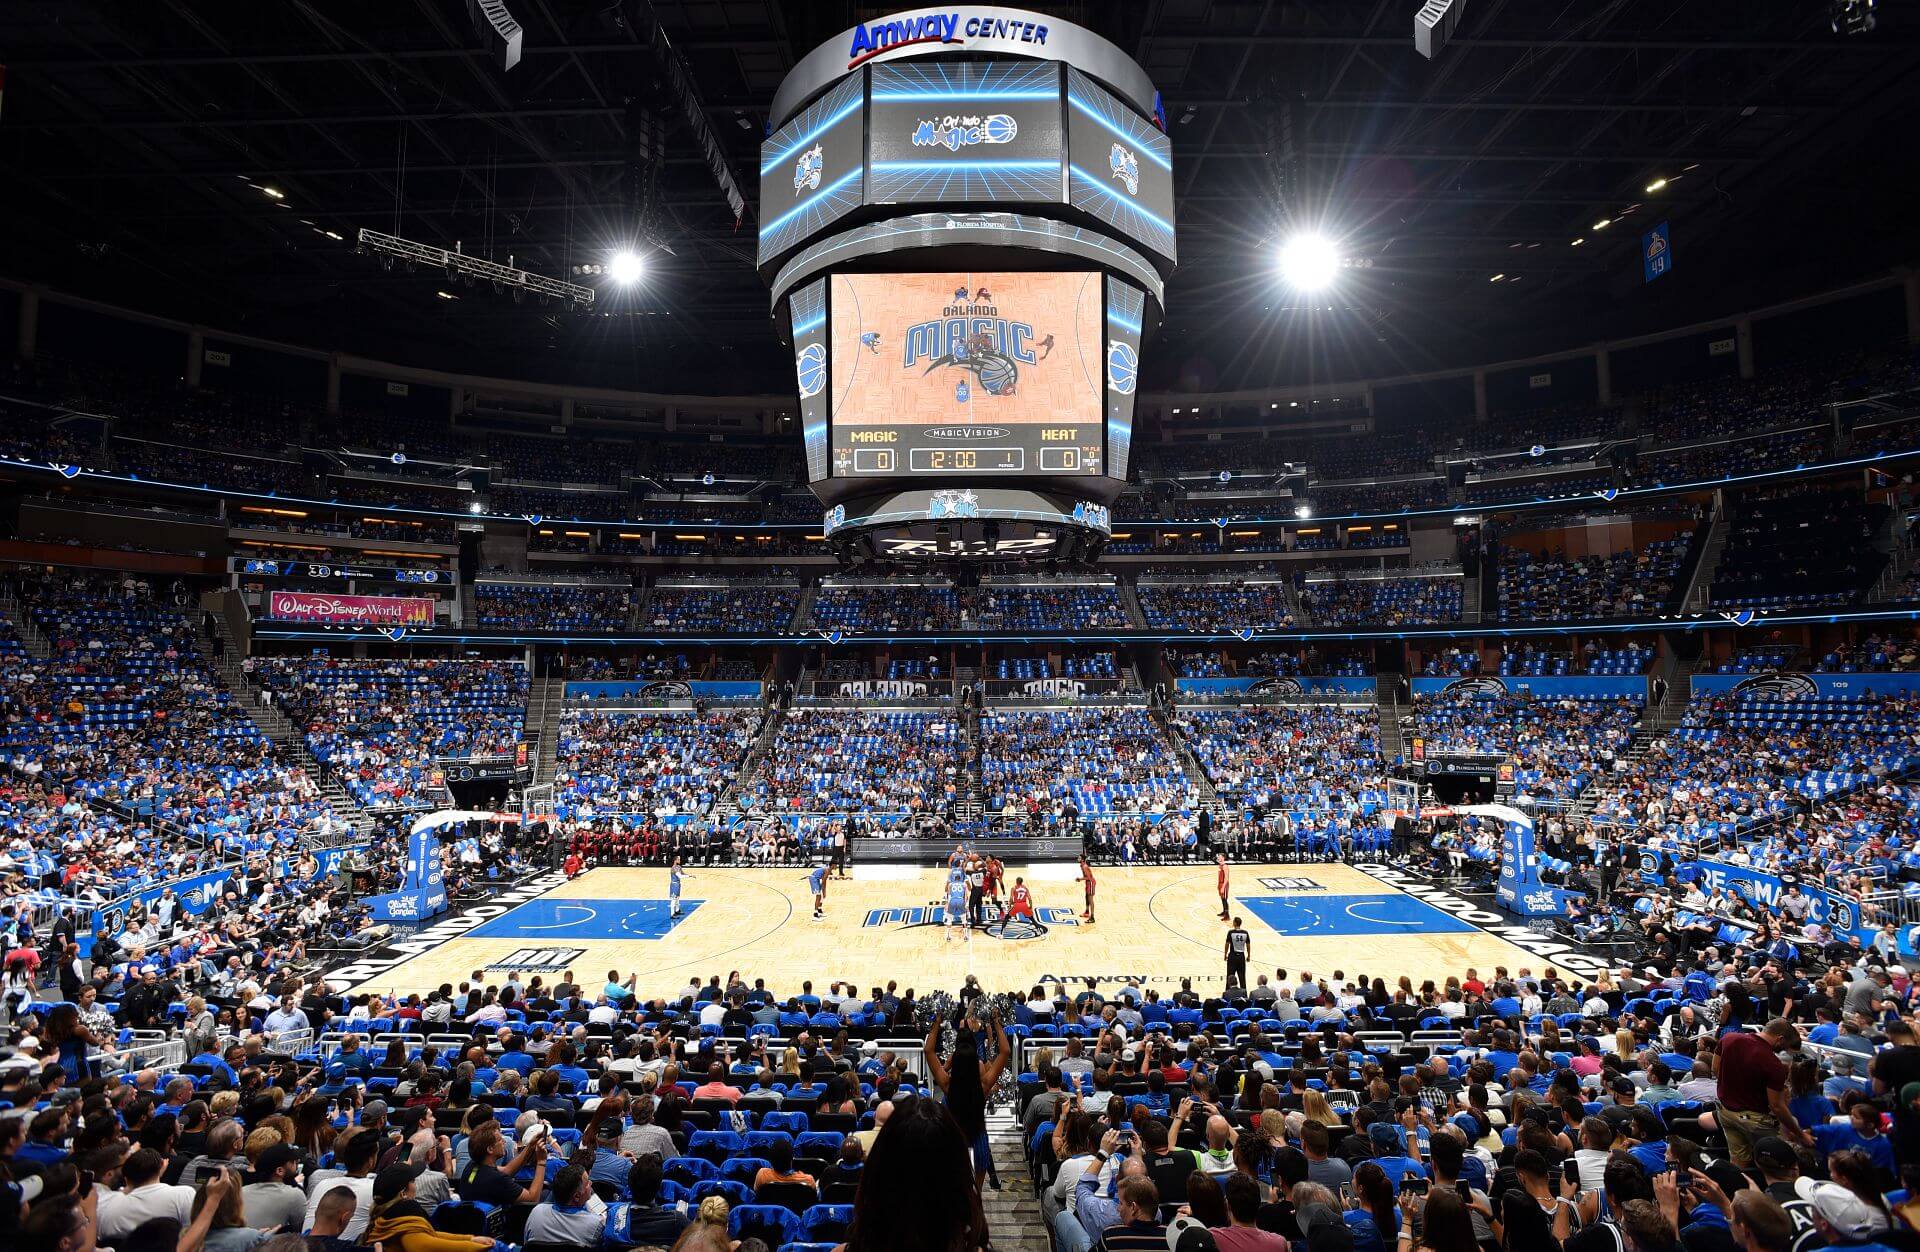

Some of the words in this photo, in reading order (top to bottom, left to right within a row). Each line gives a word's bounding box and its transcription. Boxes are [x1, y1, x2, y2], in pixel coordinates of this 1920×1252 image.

[850, 14, 959, 57] Amway
[965, 18, 1049, 46] CENTER
[1651, 256, 1665, 274] 49
[943, 305, 998, 317] ORLANDO
[904, 318, 1036, 368] MAGIC
[850, 431, 898, 443] MAGIC
[1041, 429, 1078, 441] HEAT
[877, 452, 888, 468] 0
[931, 451, 976, 469] 12:00
[1007, 452, 1011, 462] 1
[1063, 451, 1074, 468] 0
[366, 603, 402, 616] World
[1831, 681, 1849, 689] 109
[331, 849, 361, 862] PUE
[1017, 892, 1026, 900] 17
[1353, 862, 1503, 923] ORLANDO
[389, 906, 418, 917] Garden
[1527, 902, 1557, 912] Garden
[1038, 973, 1148, 985] Amway
